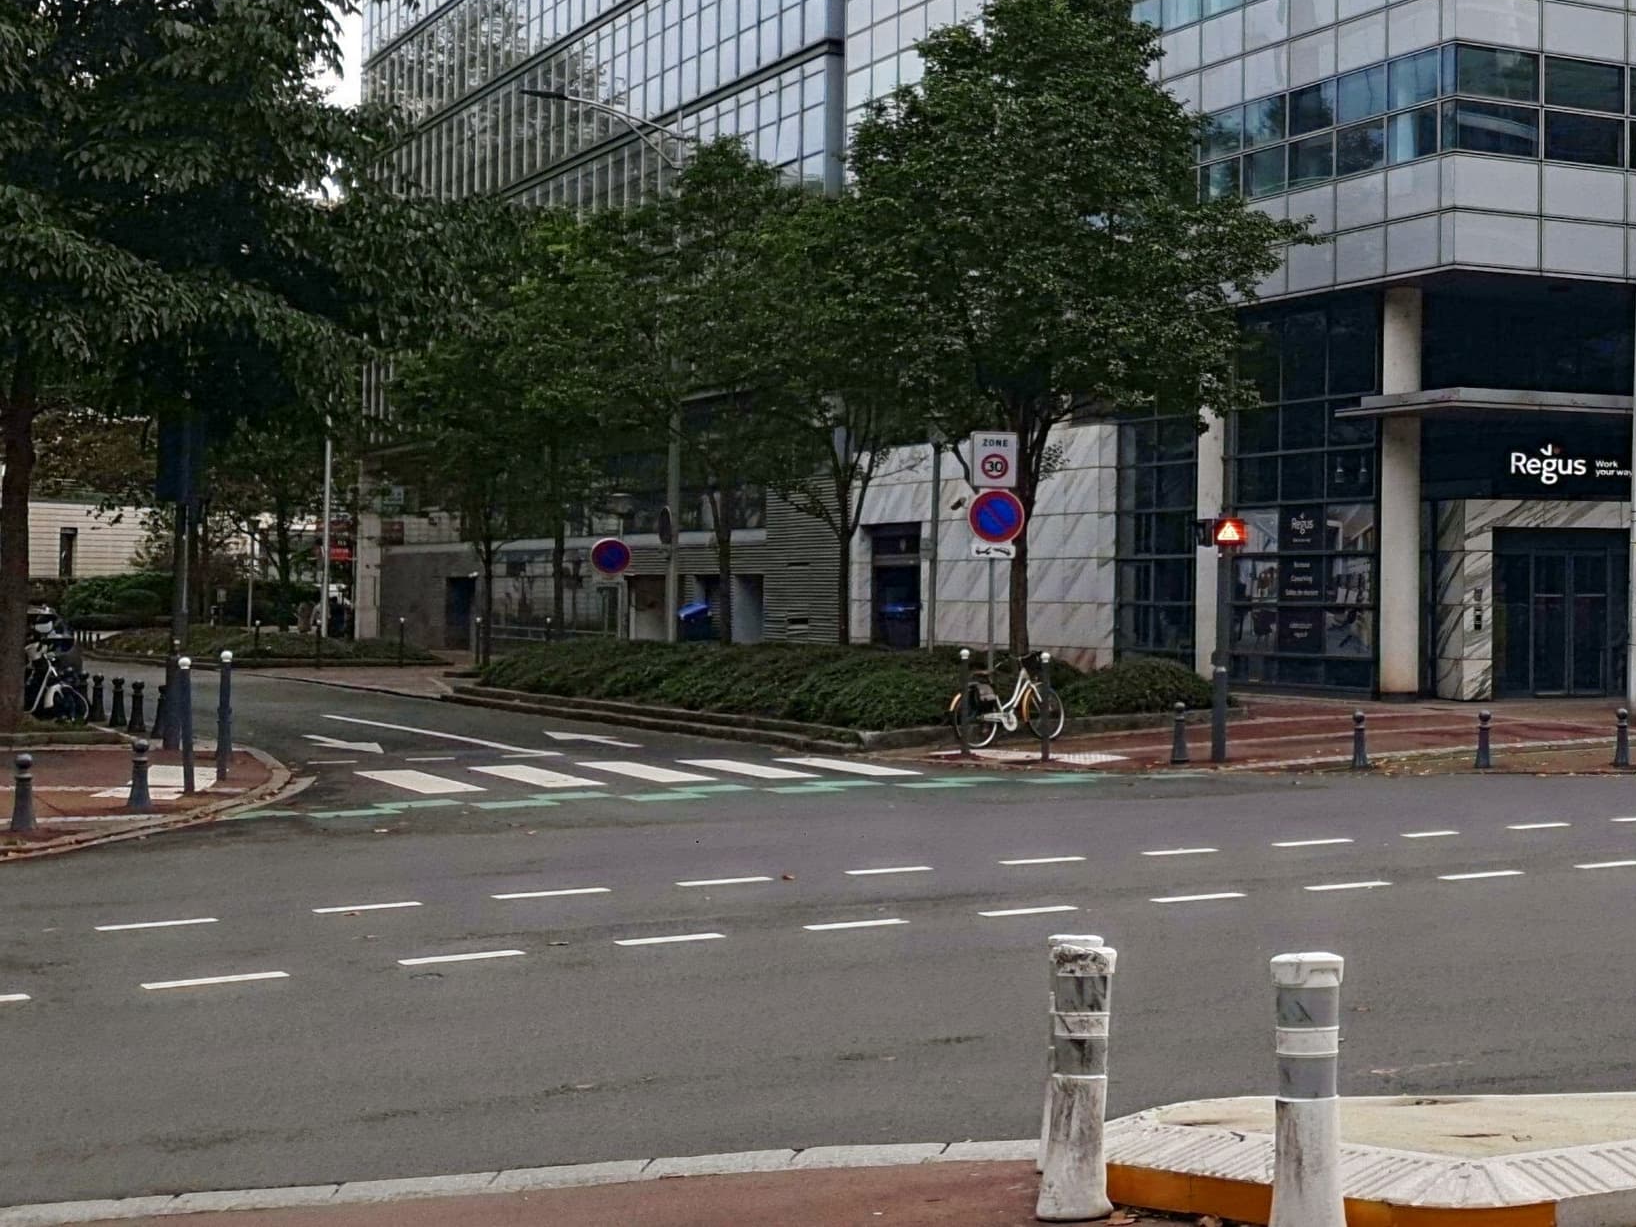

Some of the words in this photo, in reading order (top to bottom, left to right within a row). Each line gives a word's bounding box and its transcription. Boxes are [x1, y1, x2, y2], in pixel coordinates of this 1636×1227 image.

[983, 438, 1009, 448] ZONE
[985, 460, 1004, 473] 30
[1510, 451, 1587, 484] Regus
[1595, 459, 1618, 468] Work
[1595, 468, 1615, 478] your
